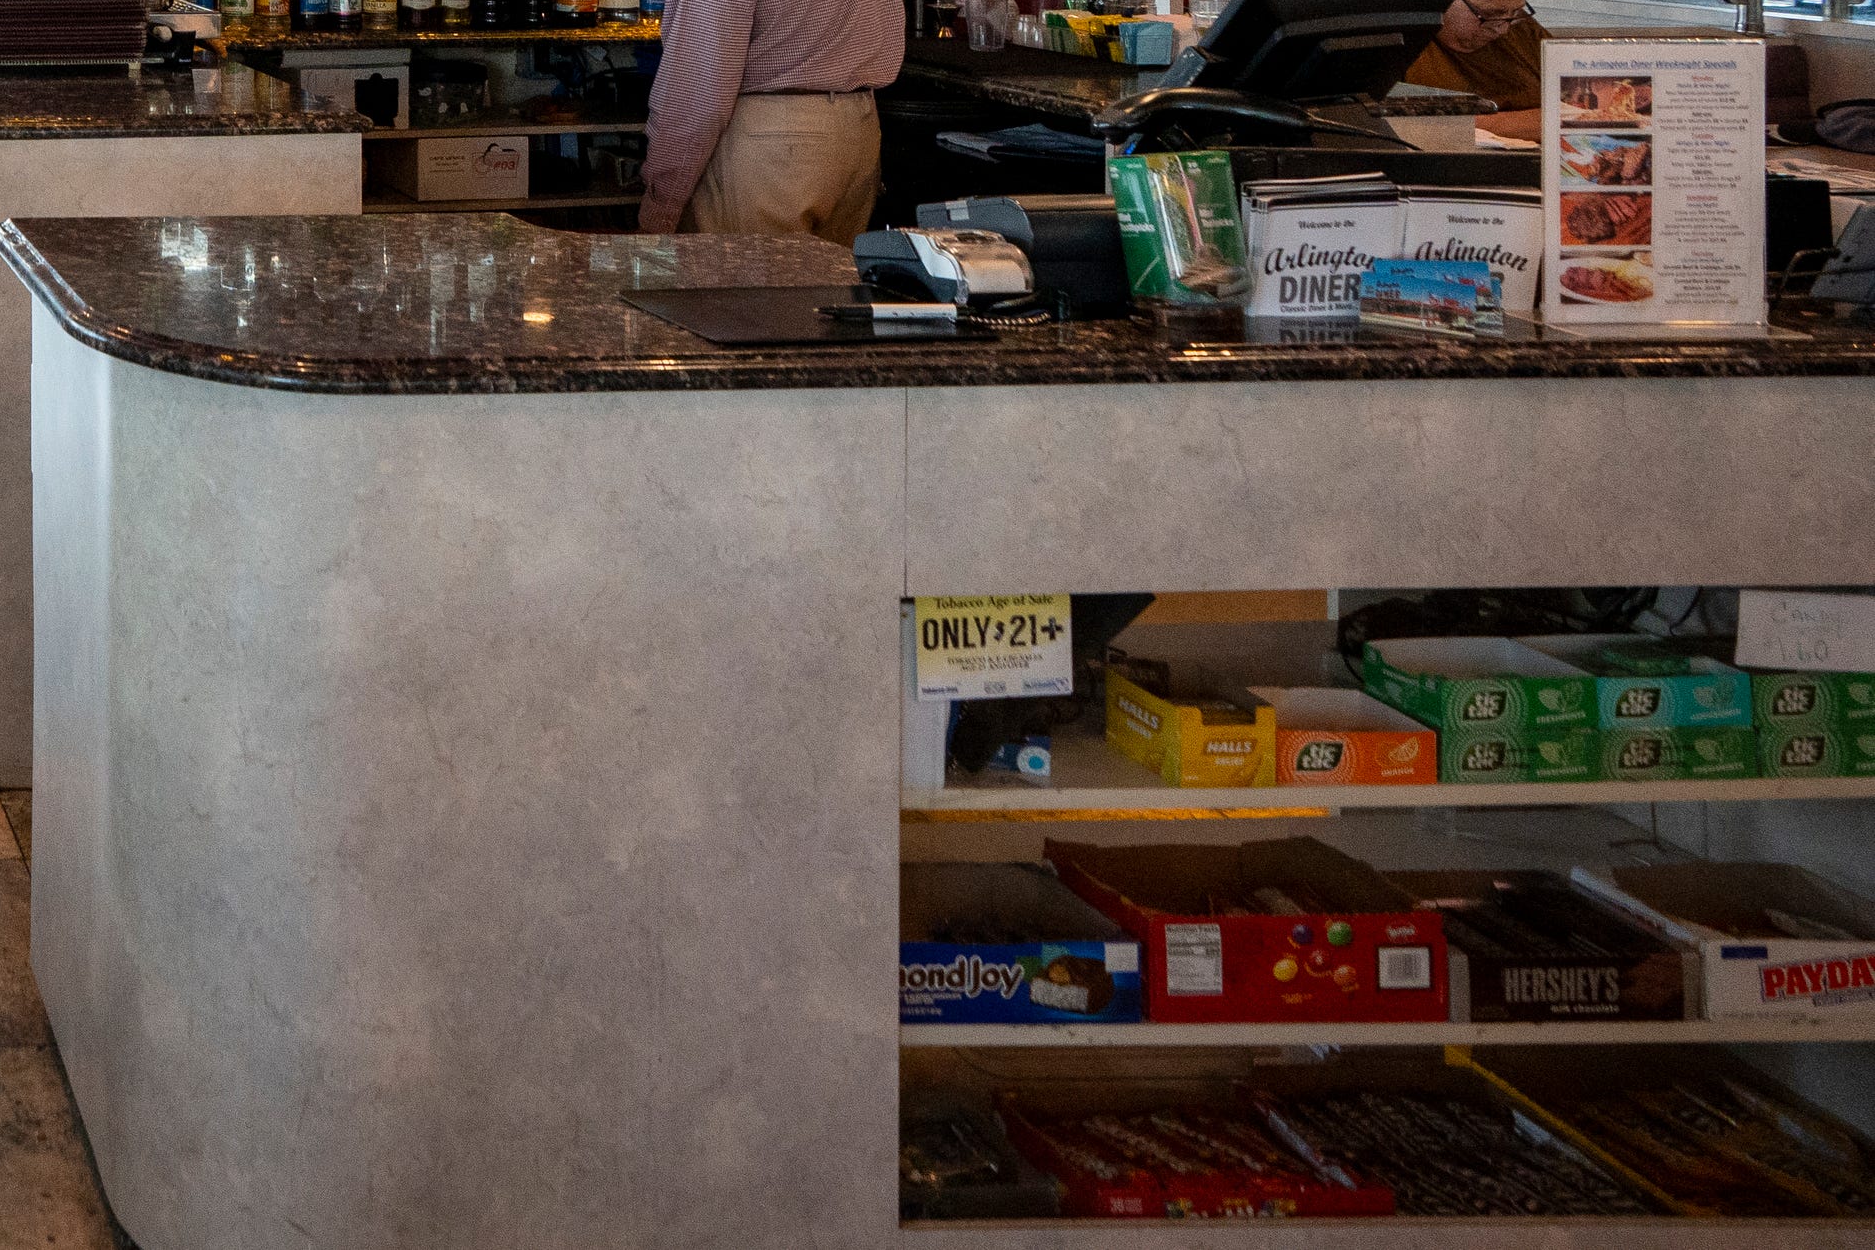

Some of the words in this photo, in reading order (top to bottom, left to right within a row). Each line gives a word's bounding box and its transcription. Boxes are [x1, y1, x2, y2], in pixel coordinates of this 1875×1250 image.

[1572, 59, 1588, 69] The
[1589, 59, 1630, 70] Arlington
[1630, 59, 1654, 69] Diner
[1655, 60, 1702, 70] Weeknight
[1702, 60, 1737, 70] Specials
[1297, 219, 1332, 230] Welcome
[1343, 219, 1357, 229] the
[1447, 214, 1481, 226] Welcome
[1492, 214, 1506, 226] the
[1278, 273, 1361, 305] DINER
[935, 597, 984, 610] Tobacco
[987, 596, 1010, 610] Age
[1012, 595, 1026, 606] of
[1028, 594, 1054, 606] Sale
[921, 615, 991, 651] ONLY
[1009, 614, 1064, 647] 21+
[1473, 692, 1503, 709] tic
[1627, 688, 1655, 704] tic
[1783, 686, 1813, 703] tic
[1467, 704, 1498, 719] tac
[1621, 700, 1653, 716] tac
[1776, 697, 1809, 714] tac
[1205, 740, 1253, 754] HALLS
[1308, 743, 1337, 759] tic
[1792, 737, 1820, 752] tic
[1301, 755, 1333, 770] tac
[1785, 749, 1815, 766] tac
[965, 953, 1026, 1000] Joy
[1502, 966, 1621, 1003] HERSHEY'S
[1549, 1003, 1571, 1014] milk
[1572, 1003, 1621, 1014] chocolate
